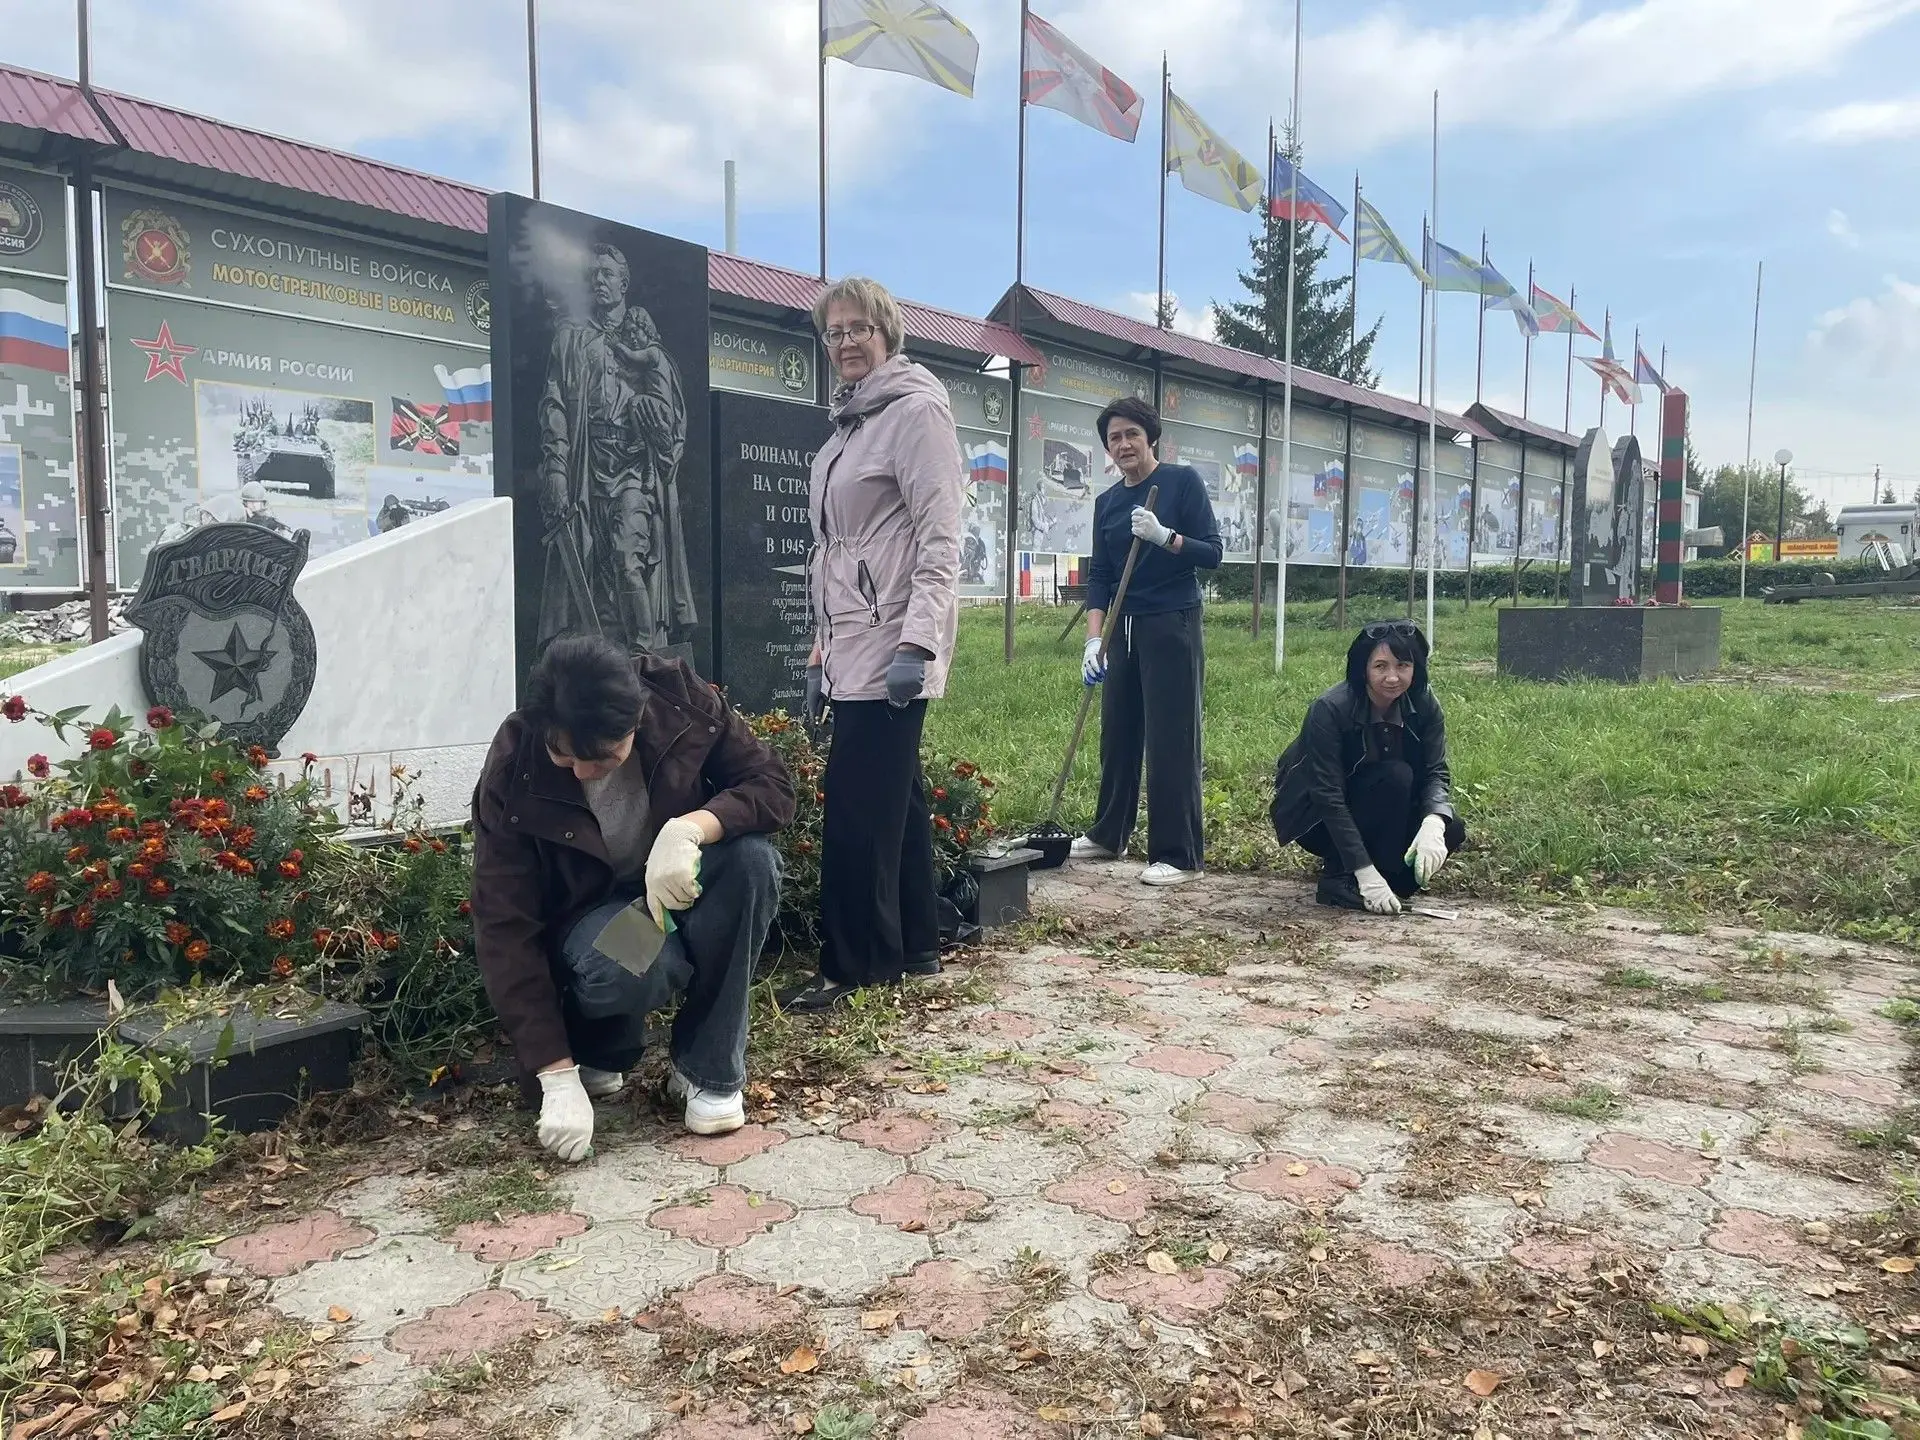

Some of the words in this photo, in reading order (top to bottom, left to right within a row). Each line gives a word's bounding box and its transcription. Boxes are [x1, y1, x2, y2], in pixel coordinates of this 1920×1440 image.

[211, 228, 361, 275] СУХОПУТНЫЕ
[369, 261, 455, 294] ВОЙСКА
[212, 262, 383, 311] МОТОСТРЕЛКОВЫЕ
[388, 297, 456, 324] ВОЙСКА
[713, 331, 768, 356] ВОЙСКА
[201, 349, 272, 373] АРМИЯ
[279, 358, 354, 382] РОССИИ
[717, 357, 776, 378] АРТИЛЛЕРИЯ
[1052, 354, 1099, 378] СУХОПУТНЫЕ
[1101, 366, 1130, 384] ВОЙСКА
[740, 442, 803, 469] ВОИНАМ,
[752, 473, 772, 492] НА
[765, 504, 776, 521] И
[766, 537, 775, 554] В
[166, 548, 288, 587] ГВАРДИЯ
[771, 686, 804, 701] Западная
